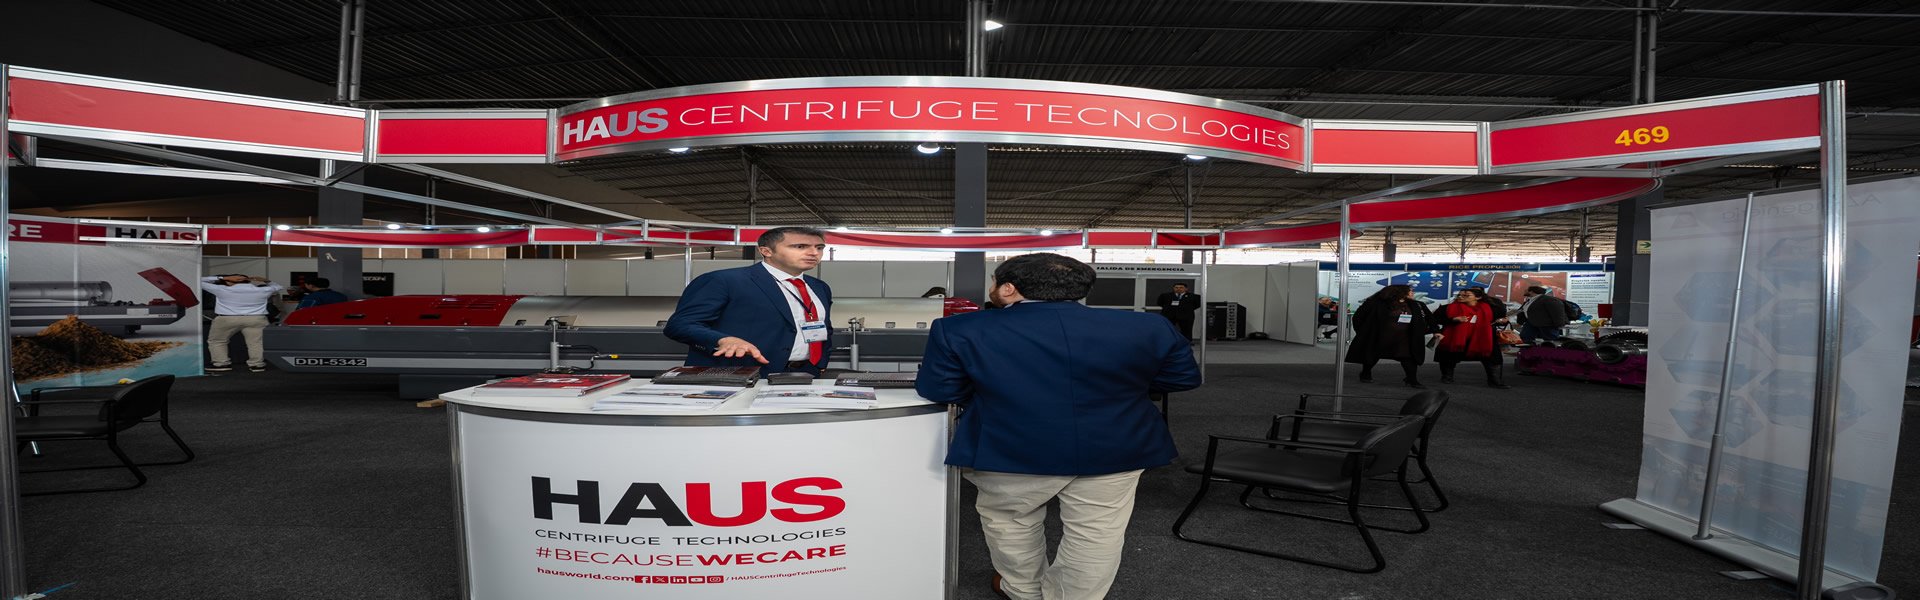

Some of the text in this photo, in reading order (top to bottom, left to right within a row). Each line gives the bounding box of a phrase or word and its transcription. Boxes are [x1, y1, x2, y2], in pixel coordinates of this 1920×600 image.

[563, 100, 1290, 150] HAUS CENTRIFUGE TECNOLOGIES
[1614, 125, 1670, 147] 469
[295, 358, 366, 366] DDI-5342
[531, 475, 846, 528] HAUS
[535, 527, 846, 546] CENTRIFUGE TECHNOLOGIES
[535, 544, 847, 568] #BECAUSEWECARE
[536, 567, 635, 582] hausworld.com
[731, 566, 847, 581] HAUSCentrifugeTechnologies
